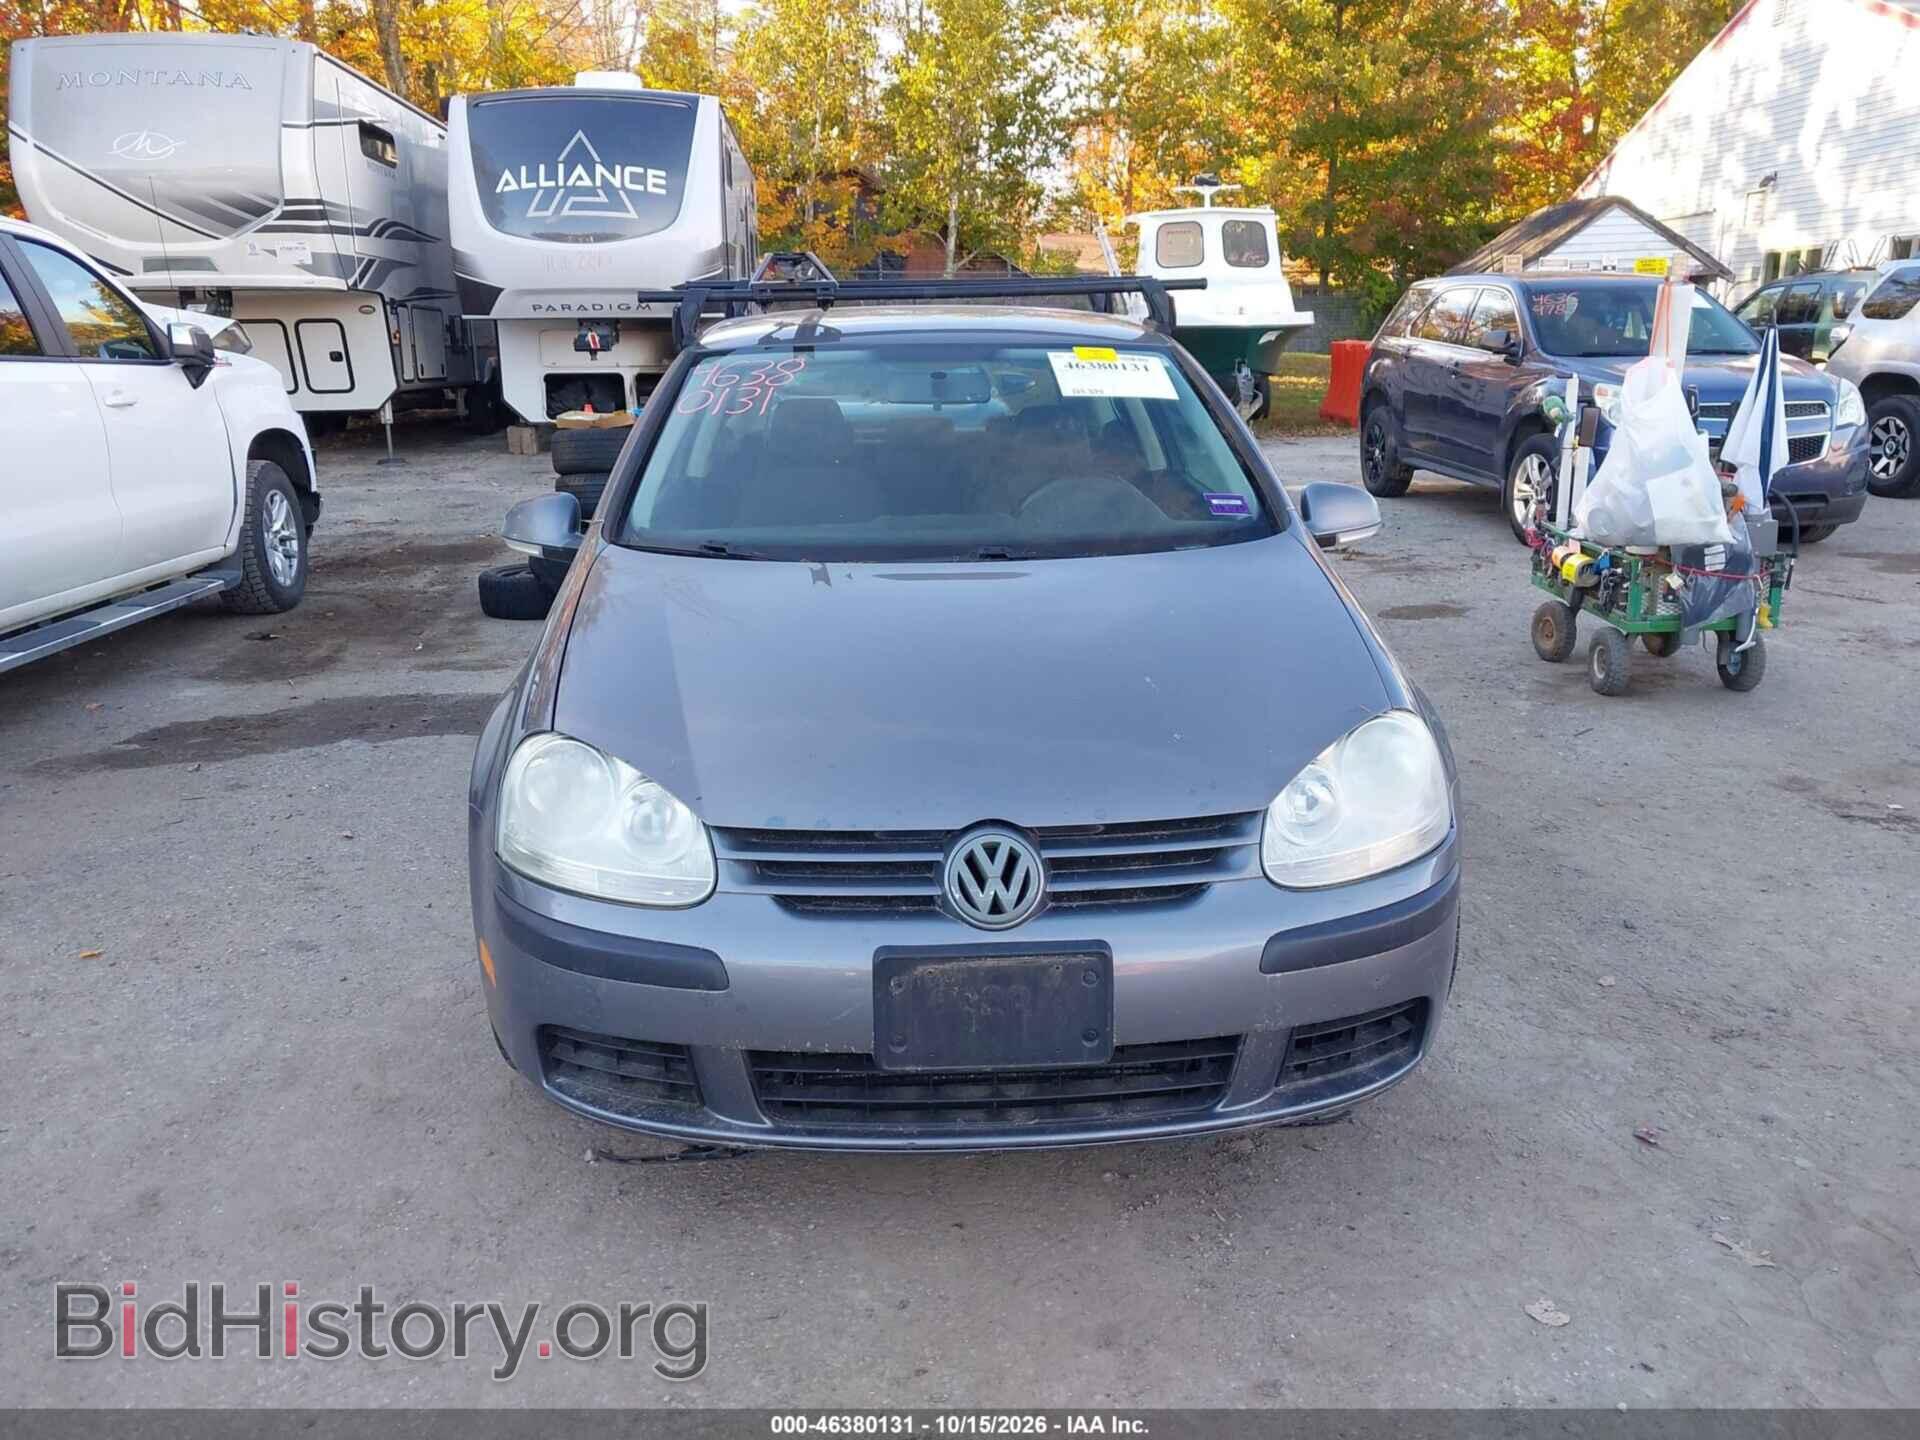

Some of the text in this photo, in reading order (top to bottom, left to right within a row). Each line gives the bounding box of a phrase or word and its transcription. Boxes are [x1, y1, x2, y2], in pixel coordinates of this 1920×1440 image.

[56, 70, 253, 90] MONTANA
[495, 163, 667, 196] ALLIANCE
[531, 302, 653, 313] PARADIGM
[1064, 361, 1150, 373] 46380131
[676, 386, 776, 416] 0131
[951, 836, 1039, 921] VW
